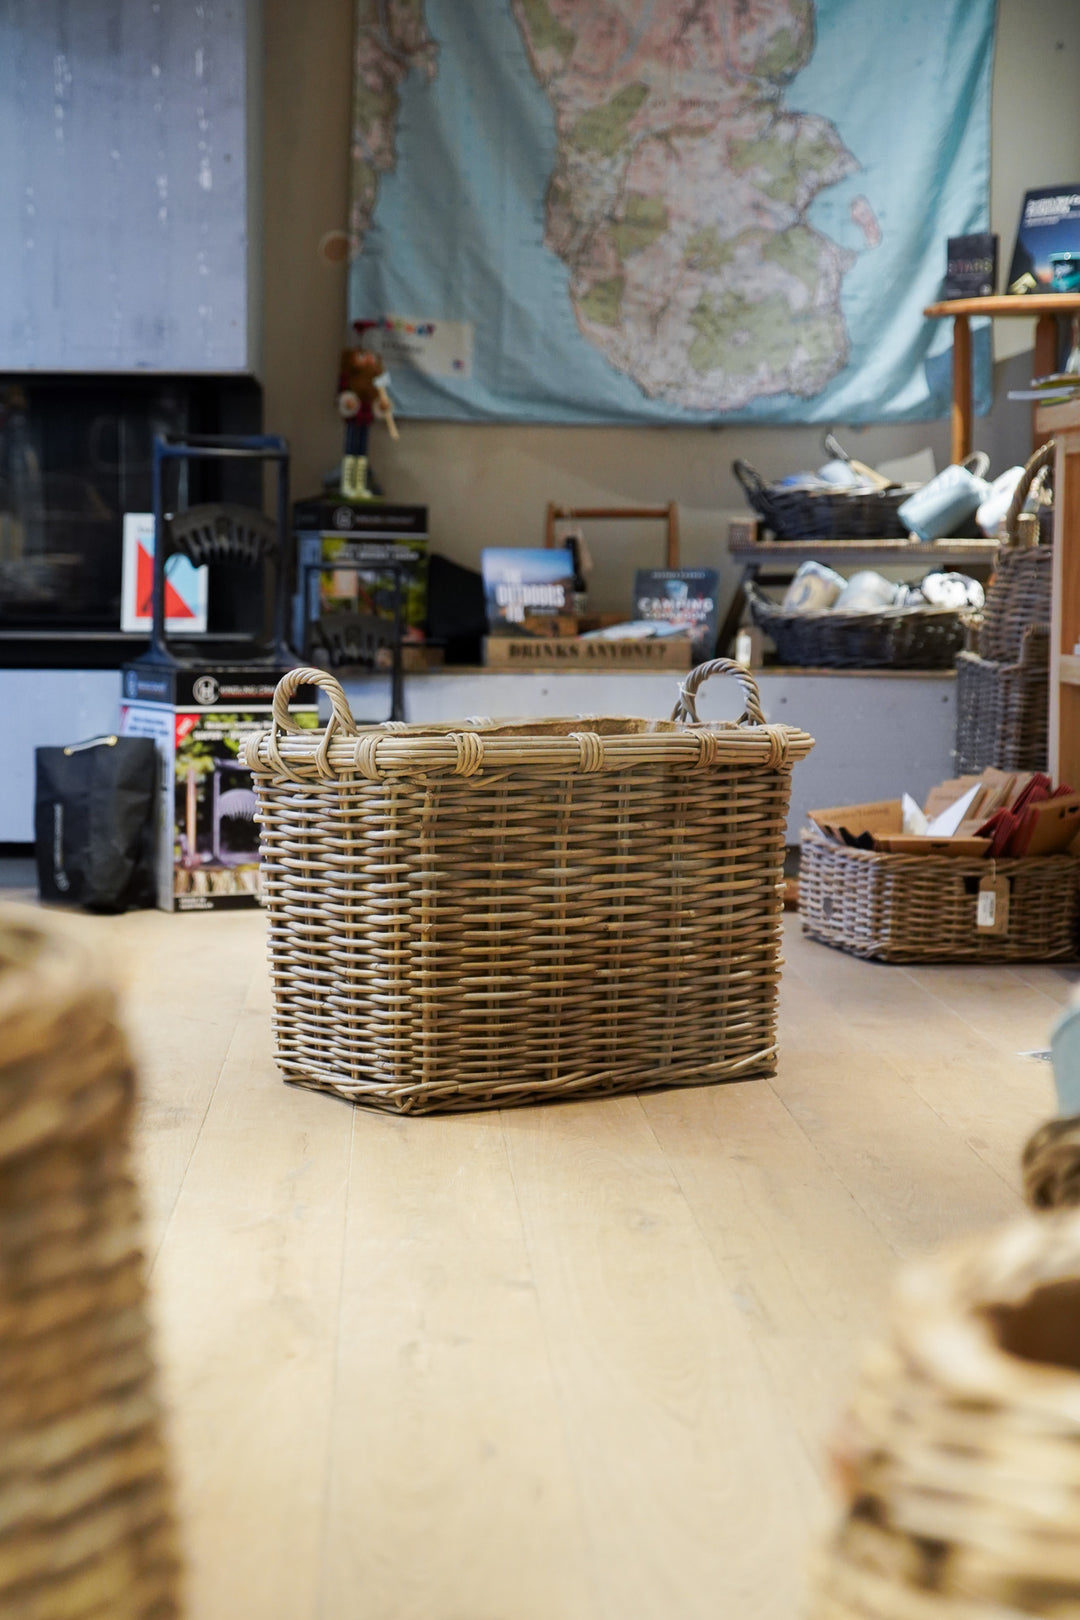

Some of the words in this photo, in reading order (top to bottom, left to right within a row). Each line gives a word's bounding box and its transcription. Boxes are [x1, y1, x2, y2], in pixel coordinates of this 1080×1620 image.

[637, 597, 714, 612] CAMPING
[509, 644, 578, 659] DRINKS
[585, 644, 667, 659] ANYONE?
